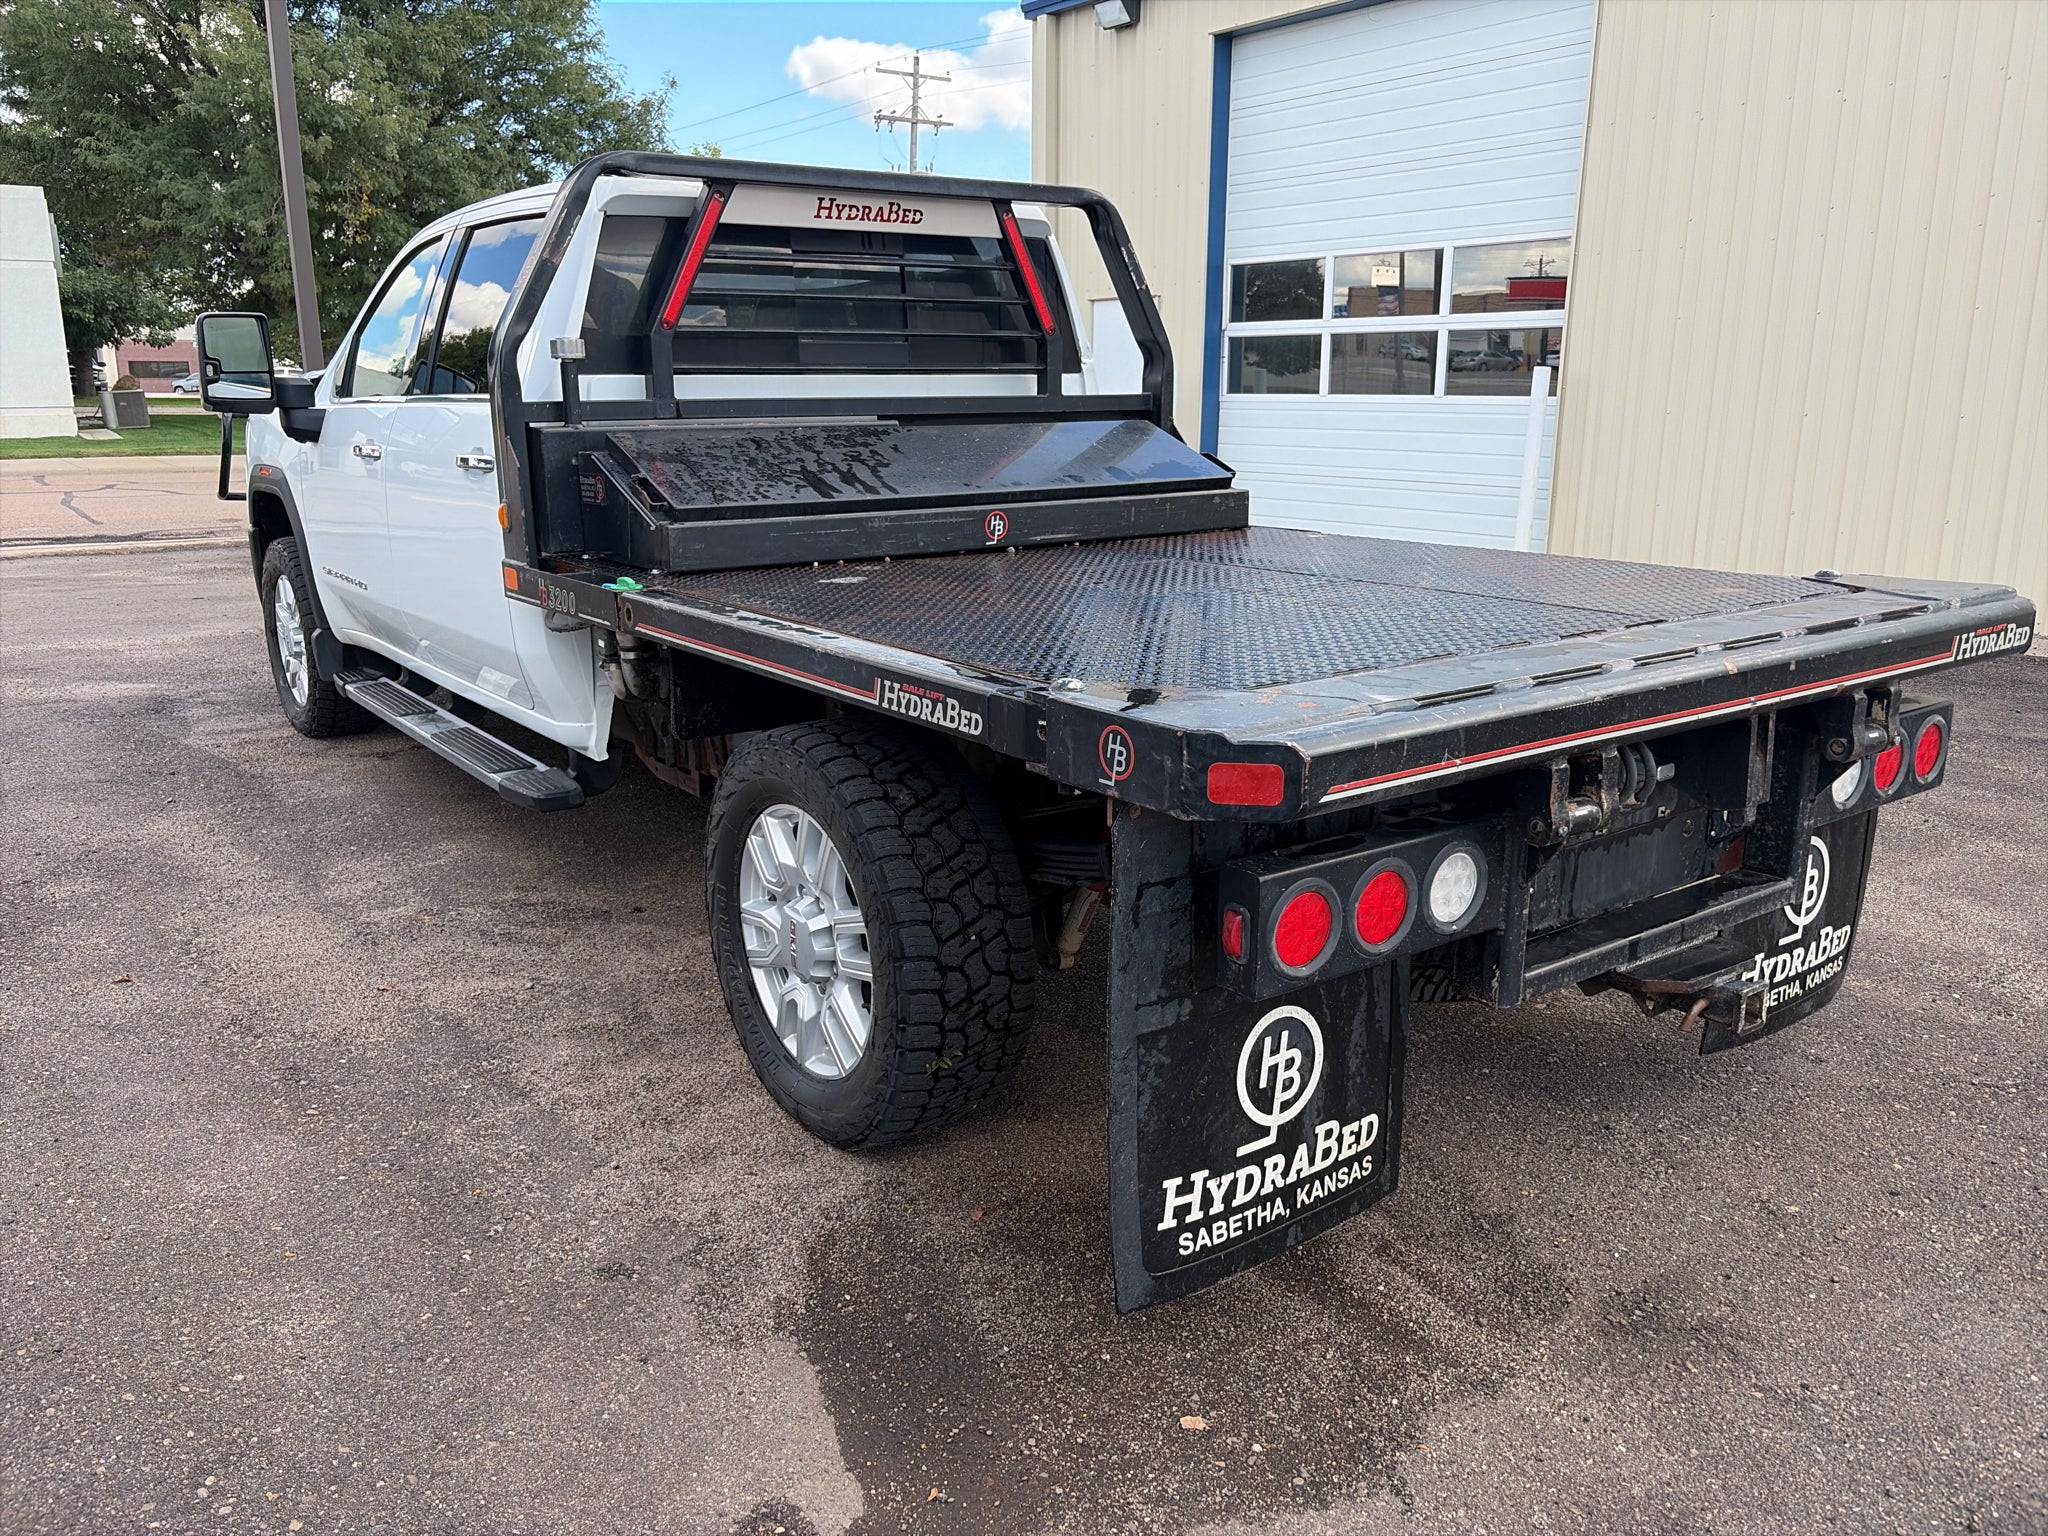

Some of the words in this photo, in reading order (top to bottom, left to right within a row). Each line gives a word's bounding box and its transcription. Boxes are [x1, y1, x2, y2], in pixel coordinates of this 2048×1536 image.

[548, 585, 576, 615] 3200
[902, 683, 924, 696] BALE
[925, 689, 945, 701] LIFT
[1805, 955, 1844, 991] KANSAS
[1178, 1196, 1290, 1256] SABETHA,
[1296, 1155, 1373, 1209] KANSAS
